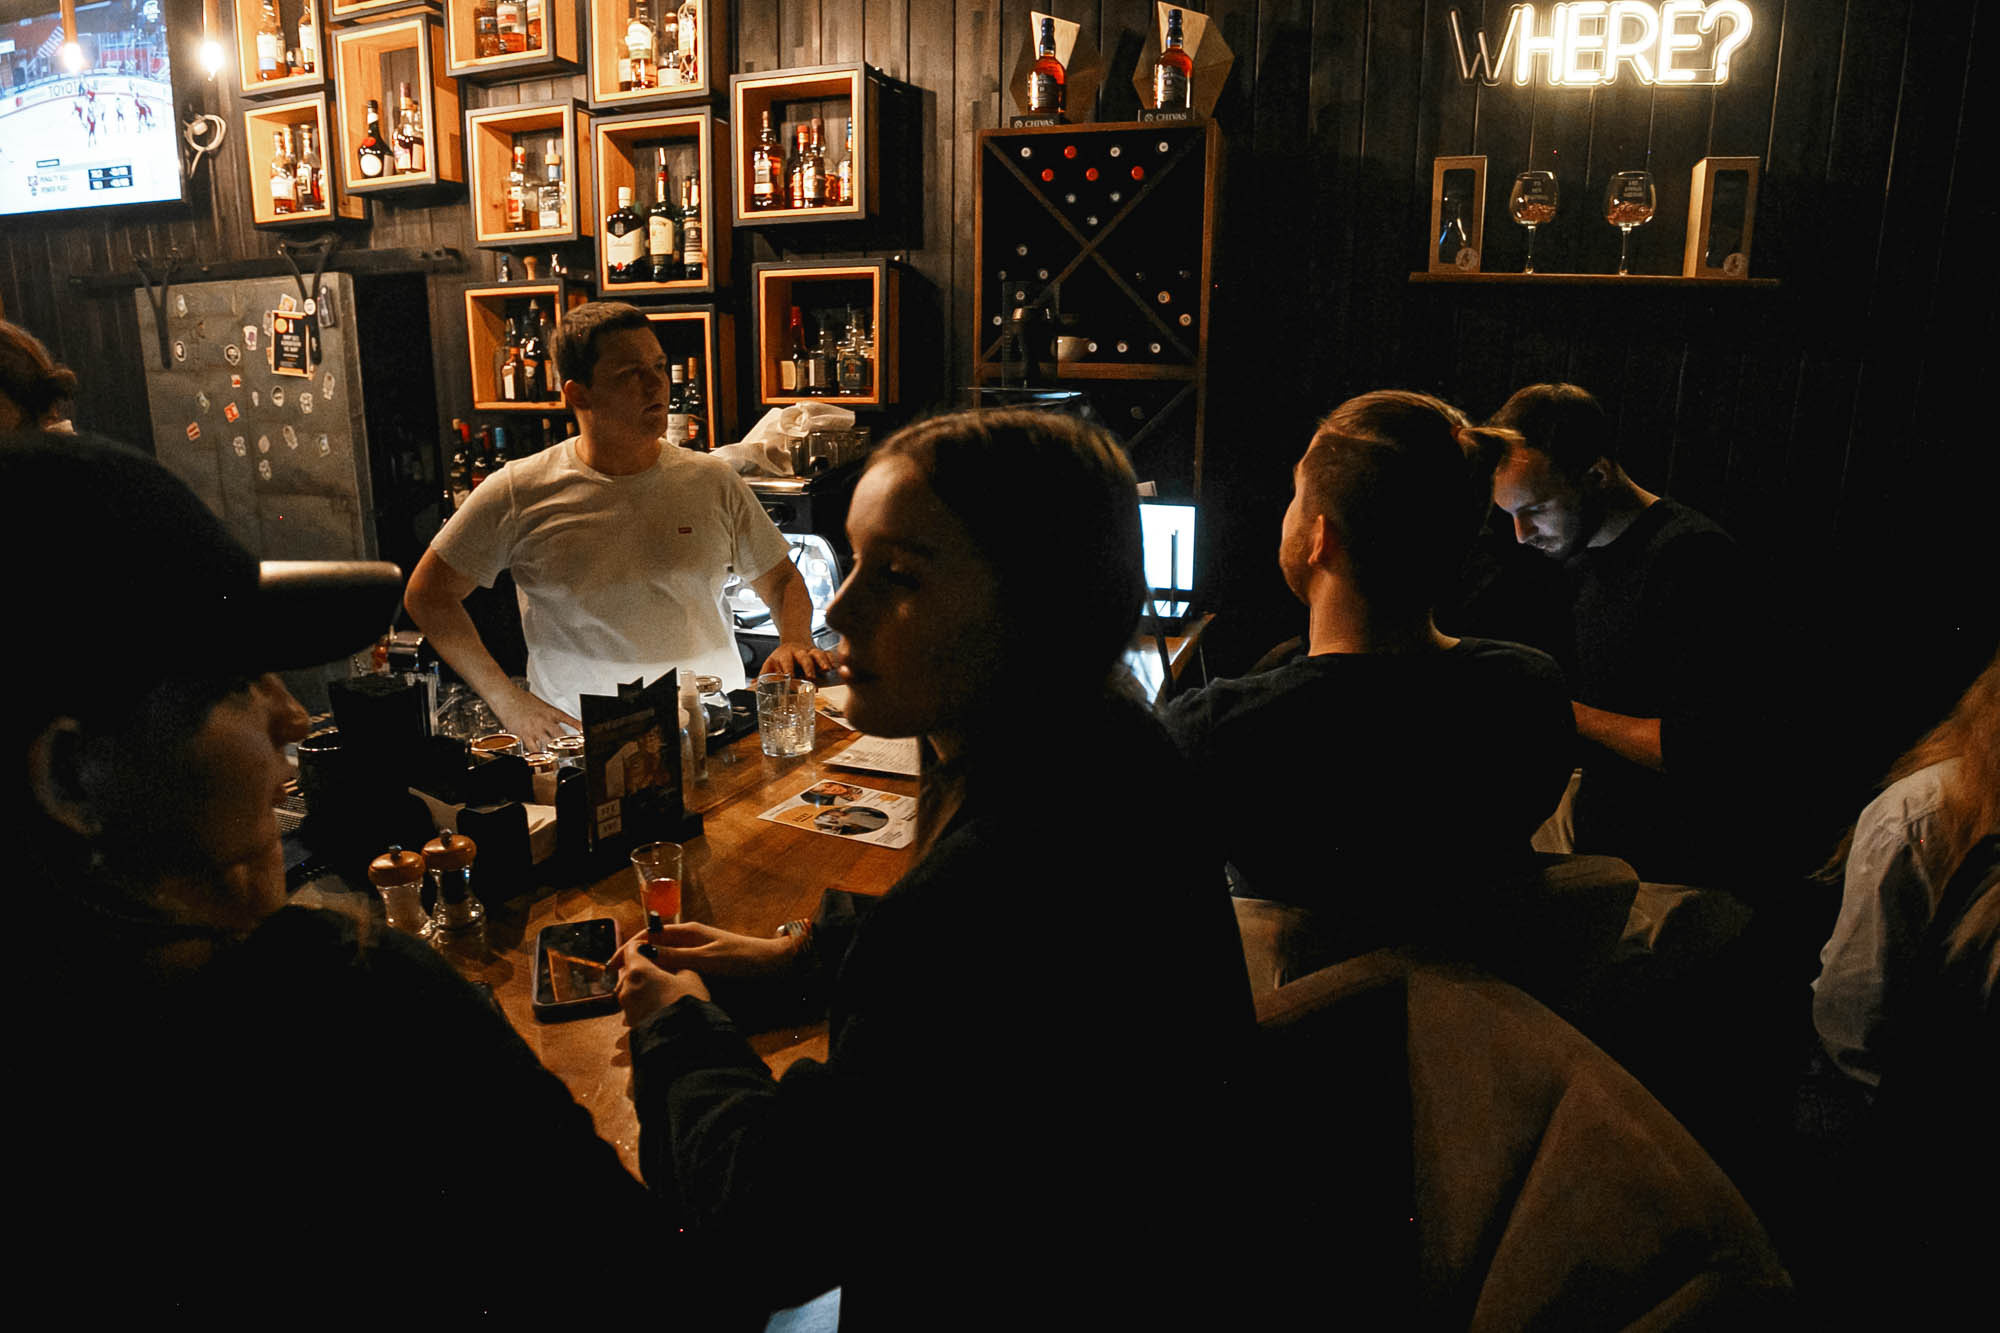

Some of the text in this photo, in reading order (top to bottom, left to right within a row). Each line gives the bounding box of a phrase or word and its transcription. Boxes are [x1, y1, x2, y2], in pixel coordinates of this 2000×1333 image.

[1449, 0, 1752, 83] WHERE?
[48, 81, 79, 97] TOYOT
[1156, 112, 1187, 121] CHIVAS
[1024, 119, 1055, 128] CHIVAS
